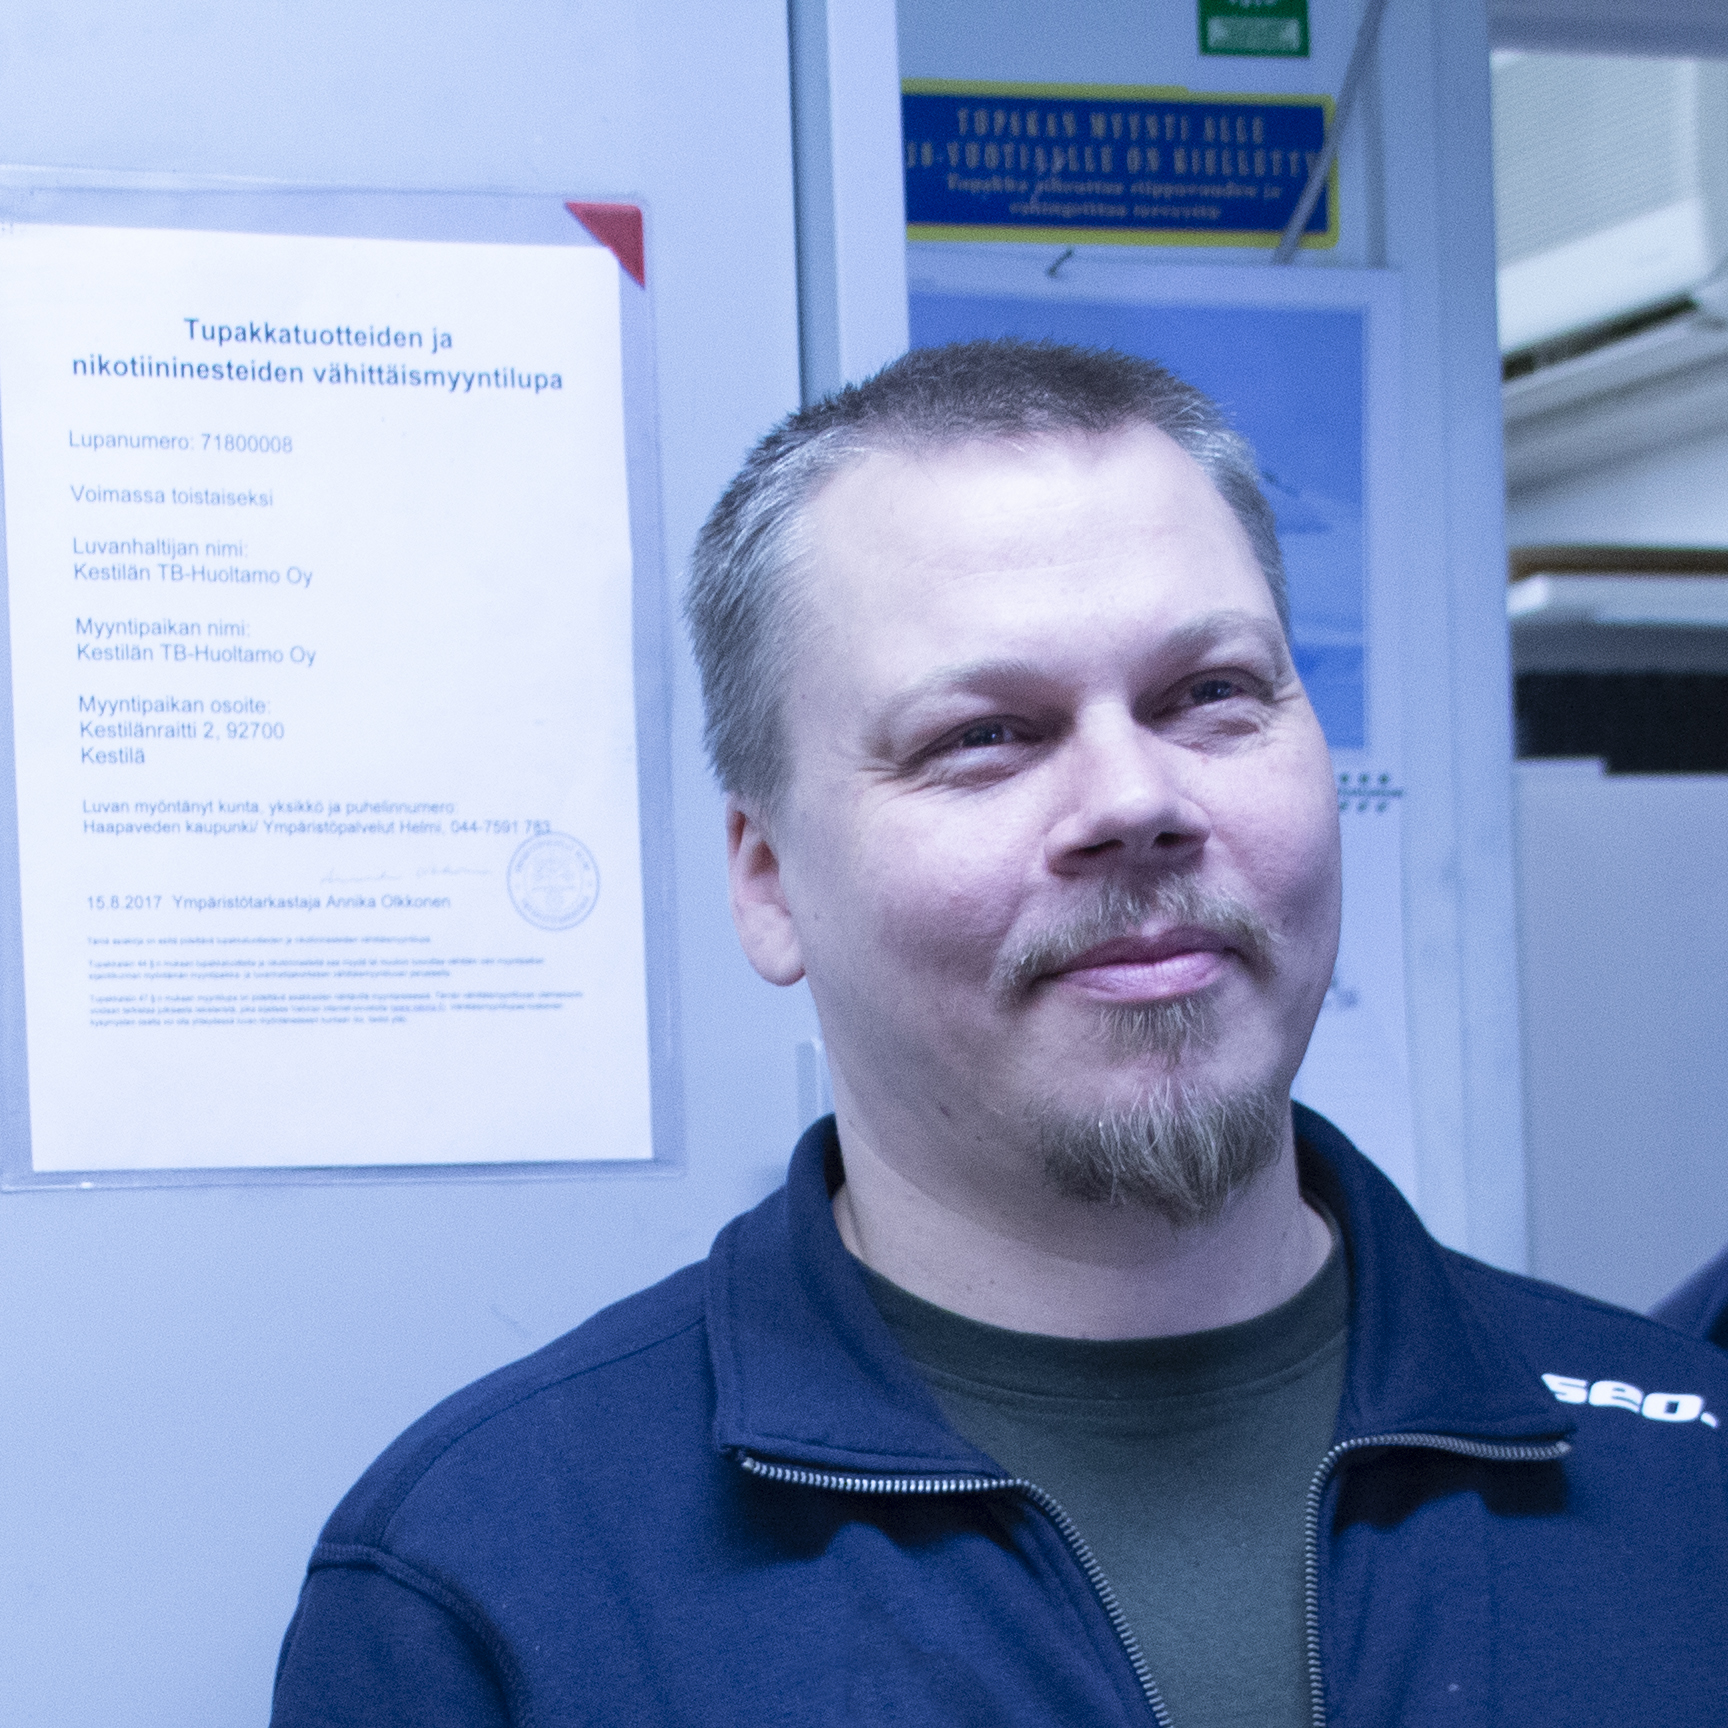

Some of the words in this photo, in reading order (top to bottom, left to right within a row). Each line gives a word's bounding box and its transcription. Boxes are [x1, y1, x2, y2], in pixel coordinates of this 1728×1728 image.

[184, 318, 423, 348] Tupakkatuotteiden
[431, 326, 453, 354] ja
[72, 354, 304, 383] nikotiininesteiden
[312, 362, 563, 393] vähittäismyyntilupa
[68, 430, 195, 451] Lupanumero:
[201, 433, 293, 453] 71800008
[70, 484, 166, 503] Voimassa
[172, 487, 274, 506] toistaiseksi
[73, 537, 199, 560] Luvanhaltijan
[205, 540, 249, 558] nimi:
[73, 563, 151, 581] Kestilän
[157, 563, 280, 584] TB-Huoltamo
[286, 566, 313, 588] Oy
[76, 617, 201, 639] Myyntipaikan
[207, 619, 251, 637] nimi:
[77, 644, 154, 661] Kestilän
[160, 644, 283, 663] TB-Huoltamo
[289, 646, 317, 668] Oy
[79, 694, 204, 717] Myyntipaikan
[210, 697, 272, 715] osoite:
[80, 721, 197, 739] Kestilänraitti
[203, 721, 220, 741] 2,
[227, 721, 285, 741] 92700
[81, 746, 146, 765] Kestilä
[82, 799, 130, 814] Luvan
[135, 799, 214, 816] myöntänyt
[328, 801, 341, 816] ja
[83, 820, 181, 836] Haapaveden
[325, 894, 377, 909] Annika
